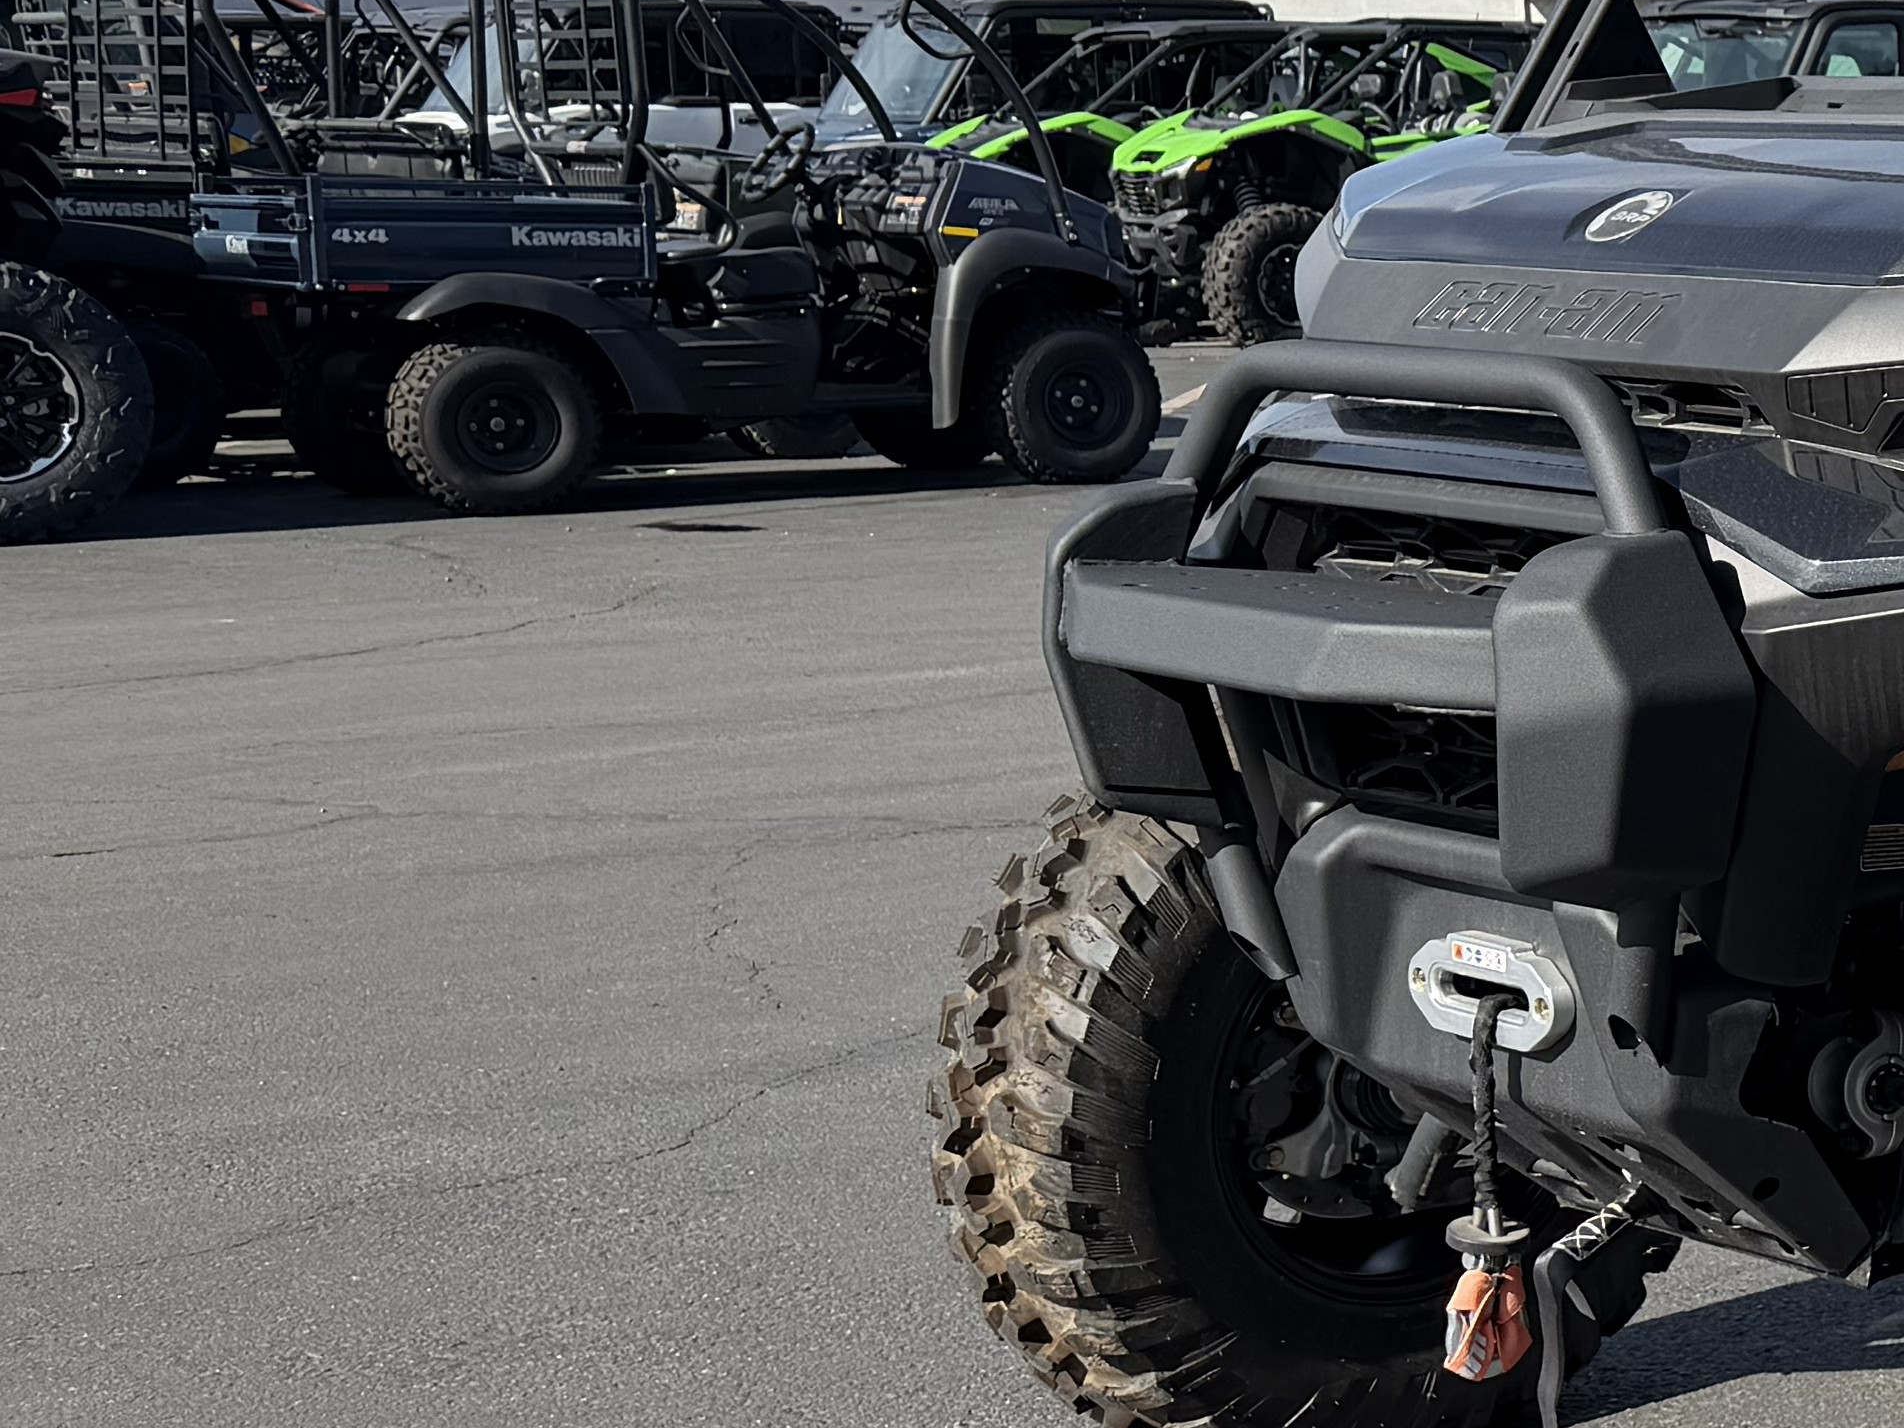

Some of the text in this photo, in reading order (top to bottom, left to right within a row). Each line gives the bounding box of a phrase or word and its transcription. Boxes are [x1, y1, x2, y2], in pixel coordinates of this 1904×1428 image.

[55, 196, 187, 219] Kawasaki
[331, 227, 390, 244] 4x4
[511, 225, 641, 247] Kawasaki
